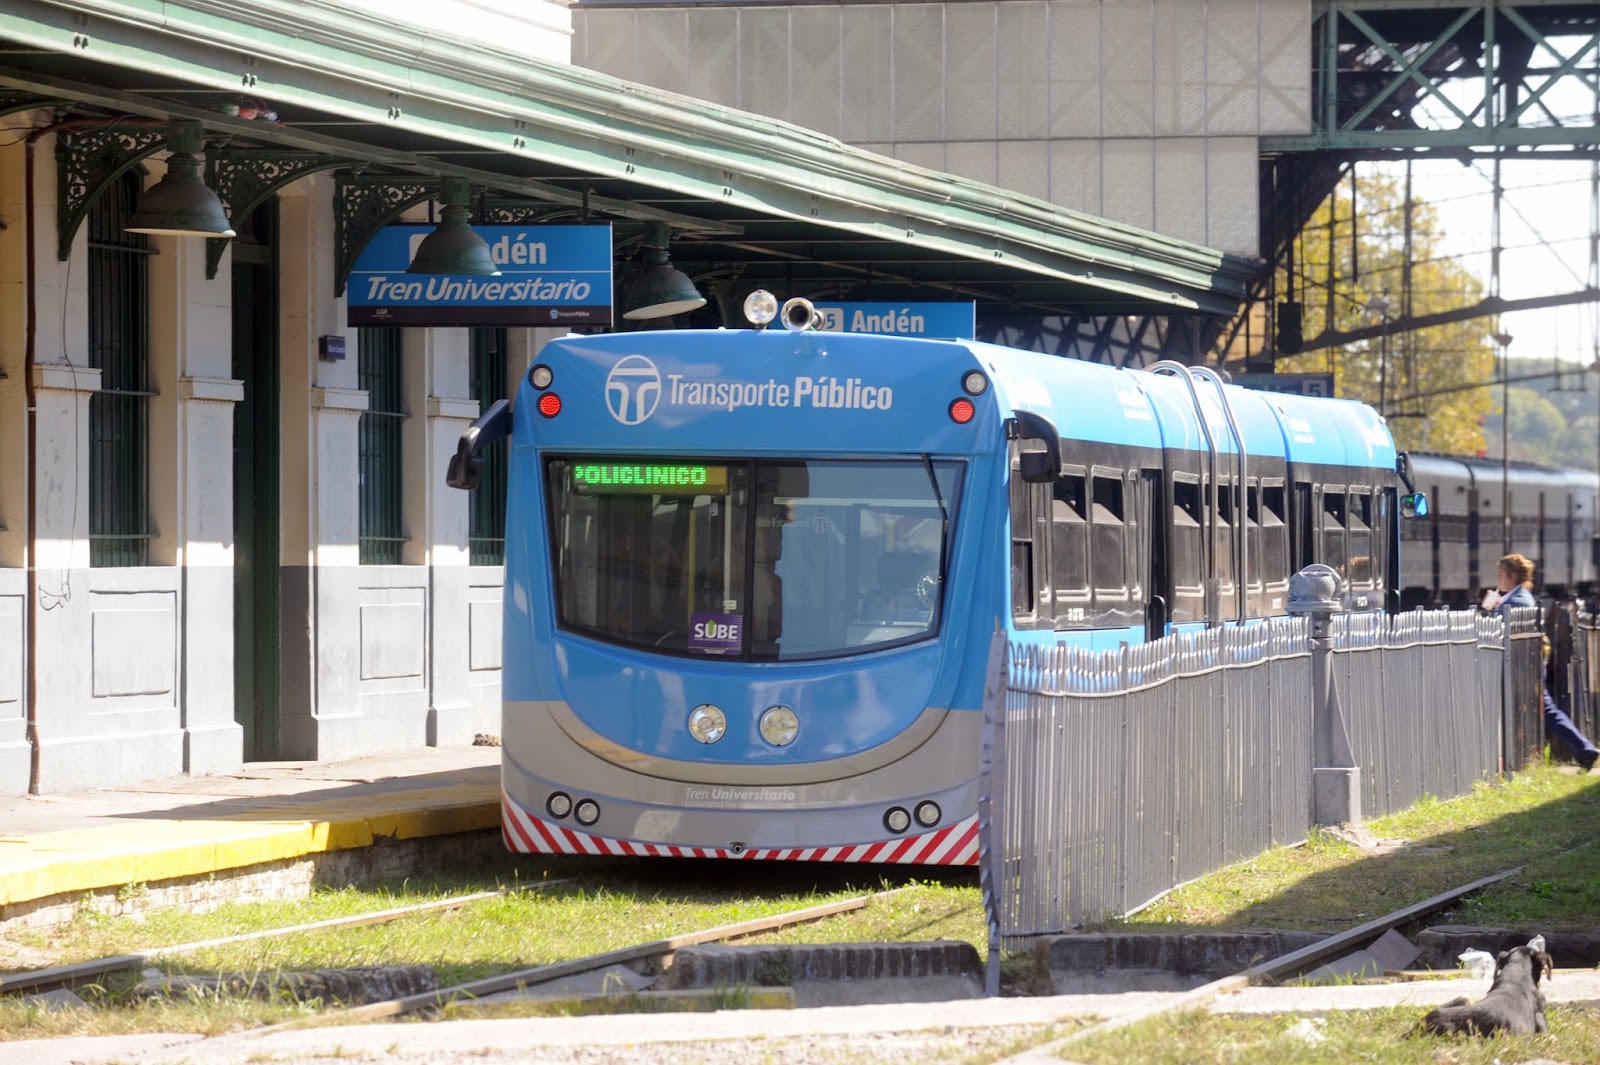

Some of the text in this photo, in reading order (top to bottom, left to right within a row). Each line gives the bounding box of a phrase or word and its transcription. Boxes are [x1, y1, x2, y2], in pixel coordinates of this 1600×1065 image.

[491, 233, 547, 265] dén
[367, 276, 591, 301] Tren Universitario
[825, 308, 925, 333] 5 Andén
[667, 374, 893, 412] Transporte Público
[694, 620, 738, 639] SUBE
[685, 787, 796, 801] Tren Universitario
